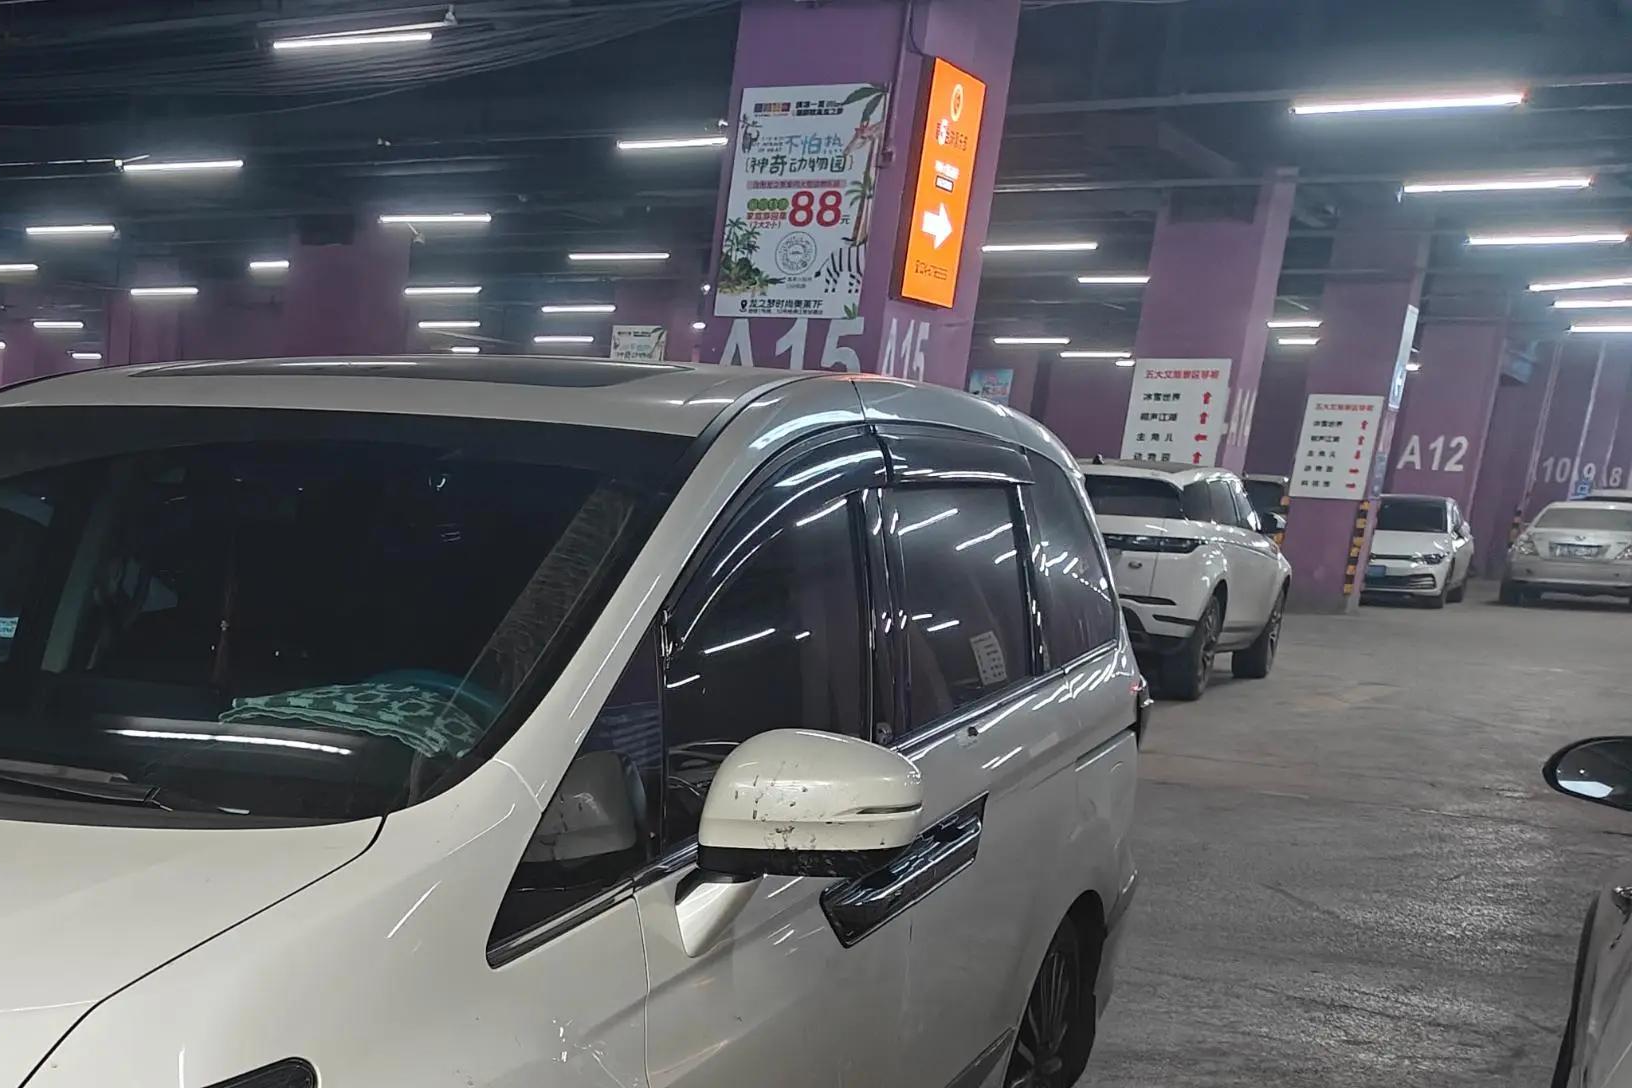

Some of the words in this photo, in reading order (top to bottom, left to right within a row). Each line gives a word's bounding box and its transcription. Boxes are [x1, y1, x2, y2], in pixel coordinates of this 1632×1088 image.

[785, 132, 844, 155] 不怕热
[789, 190, 842, 227] 88
[841, 215, 850, 224] 元
[719, 316, 865, 374] A15
[1396, 434, 1469, 472] A12
[1542, 457, 1572, 483] 10
[1582, 462, 1596, 481] 9
[1608, 467, 1622, 487] 8
